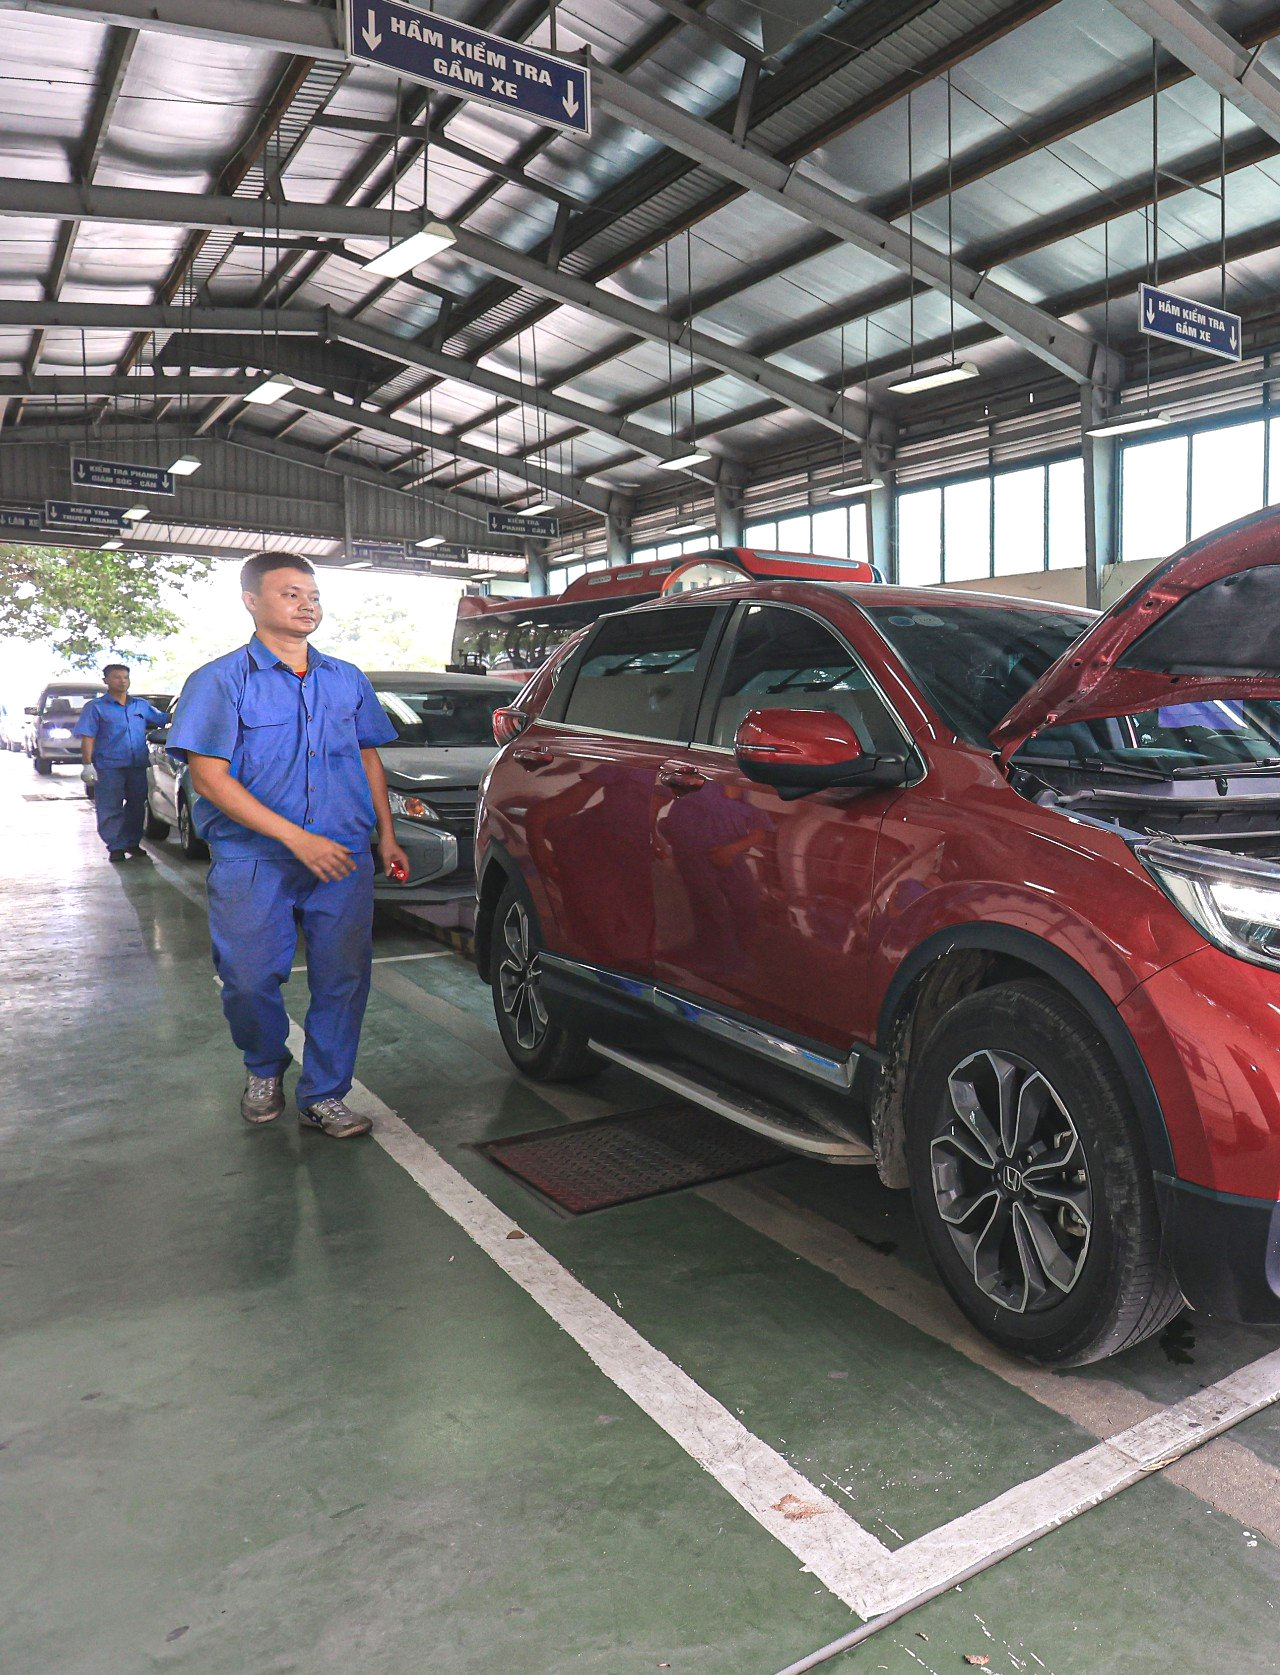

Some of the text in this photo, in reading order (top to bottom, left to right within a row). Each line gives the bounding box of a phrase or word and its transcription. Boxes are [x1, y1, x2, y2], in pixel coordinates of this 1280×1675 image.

[390, 16, 552, 88] HẦM KIỂM TRA
[433, 57, 518, 100] GẦM XE
[1158, 300, 1225, 332] HẦM KIỂM TRA
[1175, 321, 1211, 342] GẦM XE
[113, 468, 128, 476] TRA
